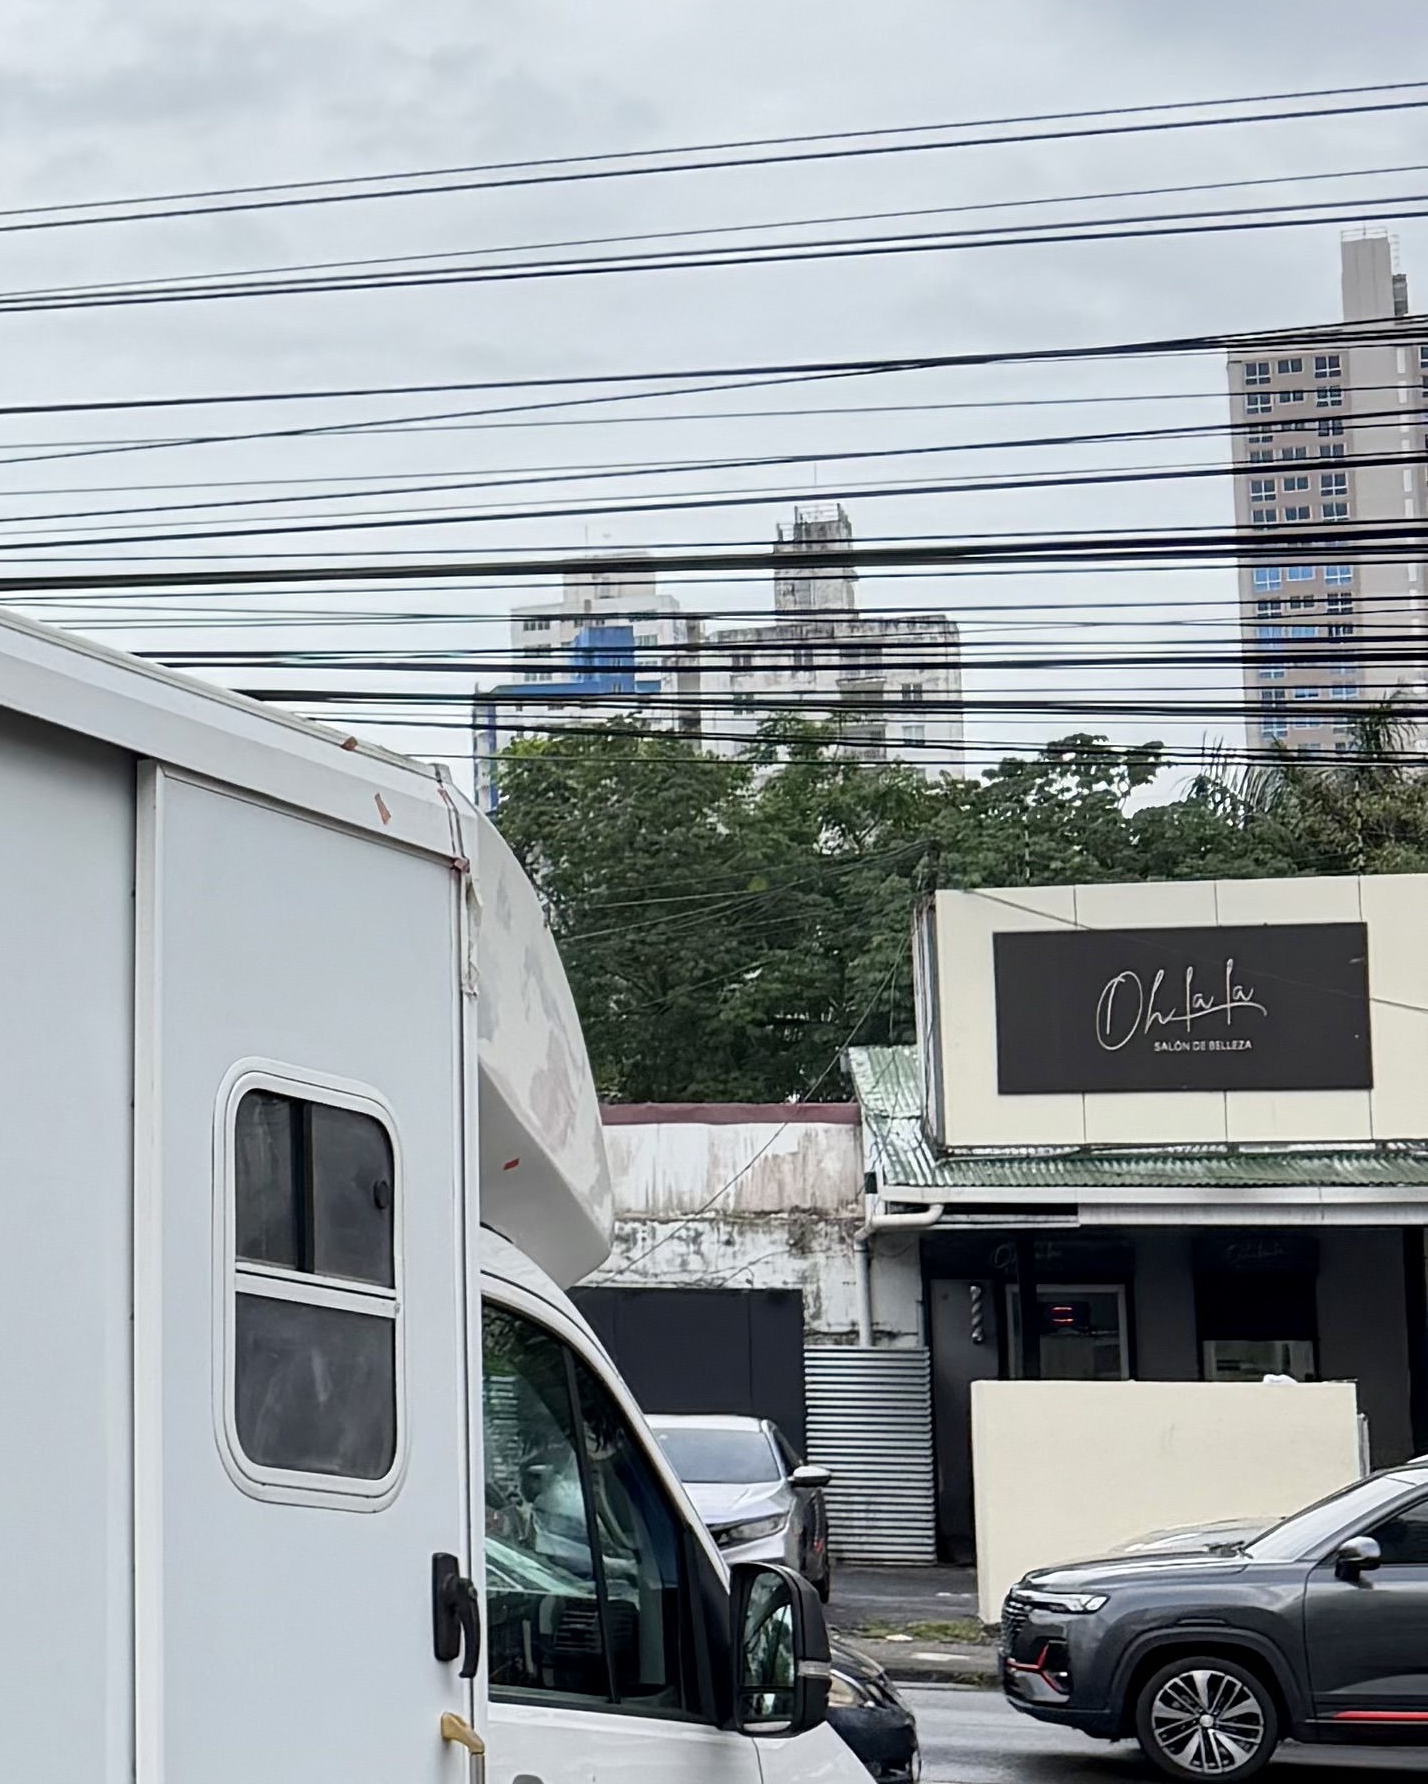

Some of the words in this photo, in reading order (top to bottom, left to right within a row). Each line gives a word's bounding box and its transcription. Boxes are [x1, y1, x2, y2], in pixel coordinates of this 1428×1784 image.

[1096, 971, 1176, 1050] Oh
[1154, 1040, 1190, 1051] SALÓN
[1192, 1040, 1206, 1051] DE
[1209, 1040, 1252, 1050] BELLEZA
